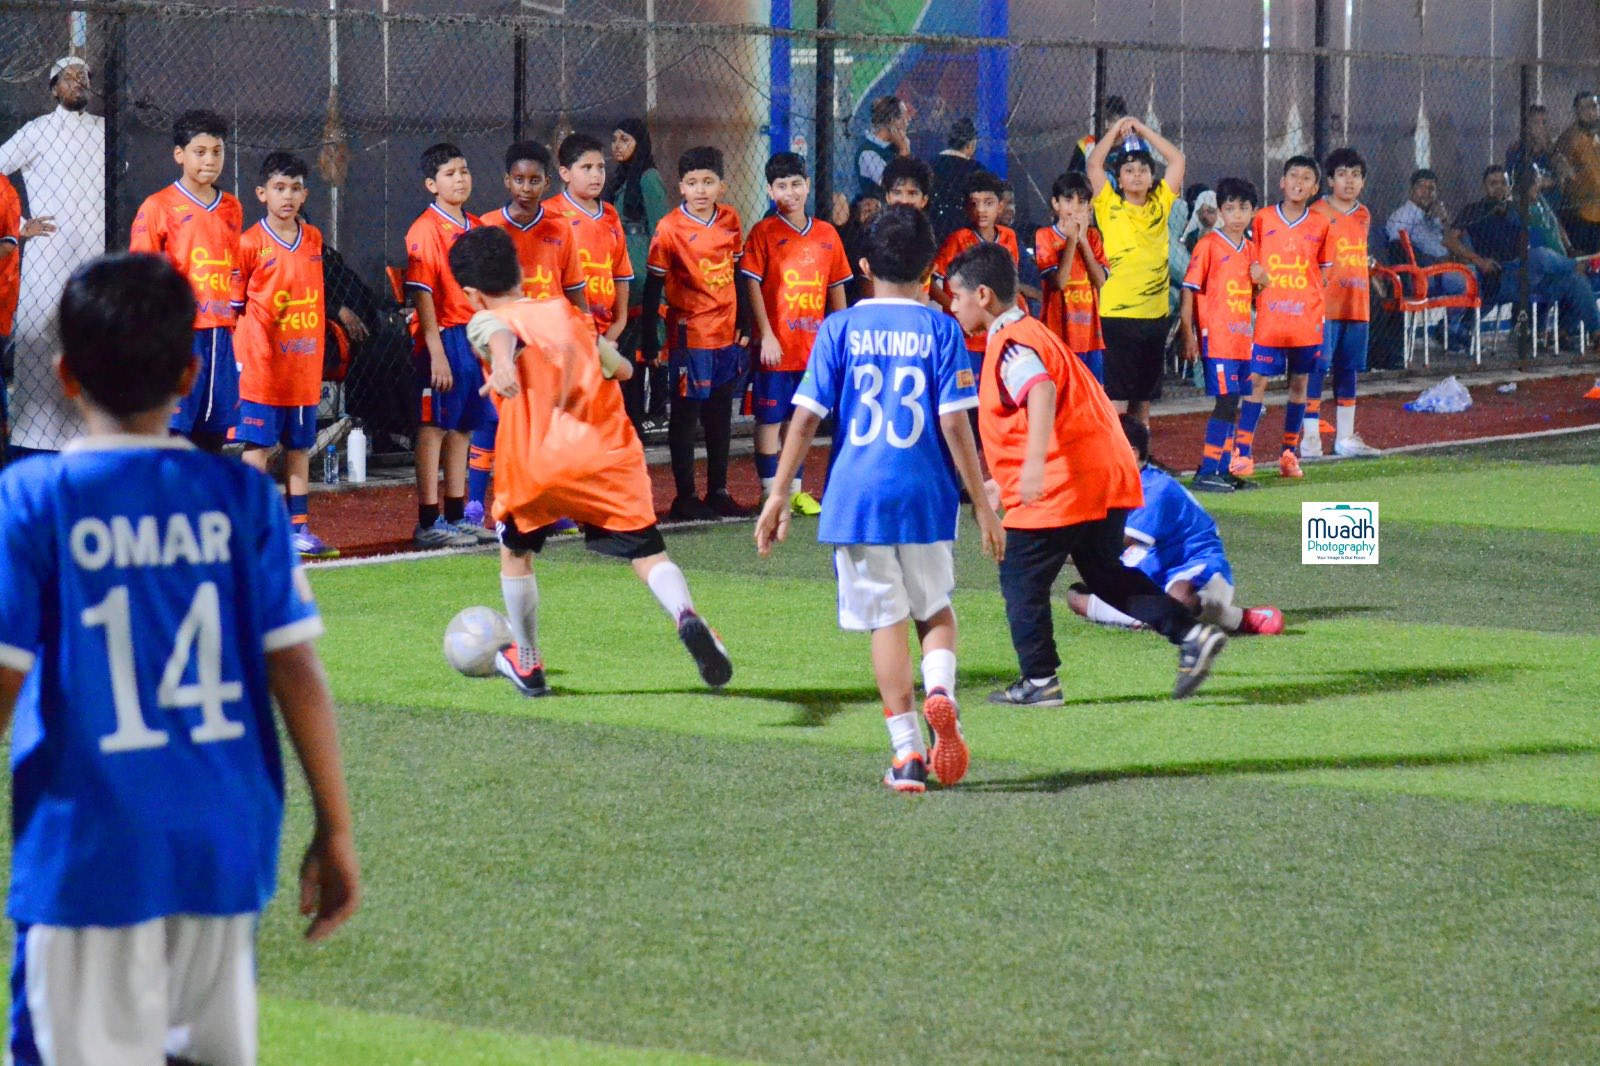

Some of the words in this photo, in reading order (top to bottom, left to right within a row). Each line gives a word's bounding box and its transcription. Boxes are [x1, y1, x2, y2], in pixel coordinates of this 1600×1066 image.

[1268, 254, 1309, 274] يلو
[1267, 273, 1308, 290] YELO
[274, 287, 318, 311] يلو
[784, 292, 823, 311] YELO
[274, 311, 318, 332] YELO
[850, 329, 932, 358] SAKINDU
[850, 364, 926, 448] 33
[70, 511, 232, 570] OMAR
[81, 581, 245, 753] 14
